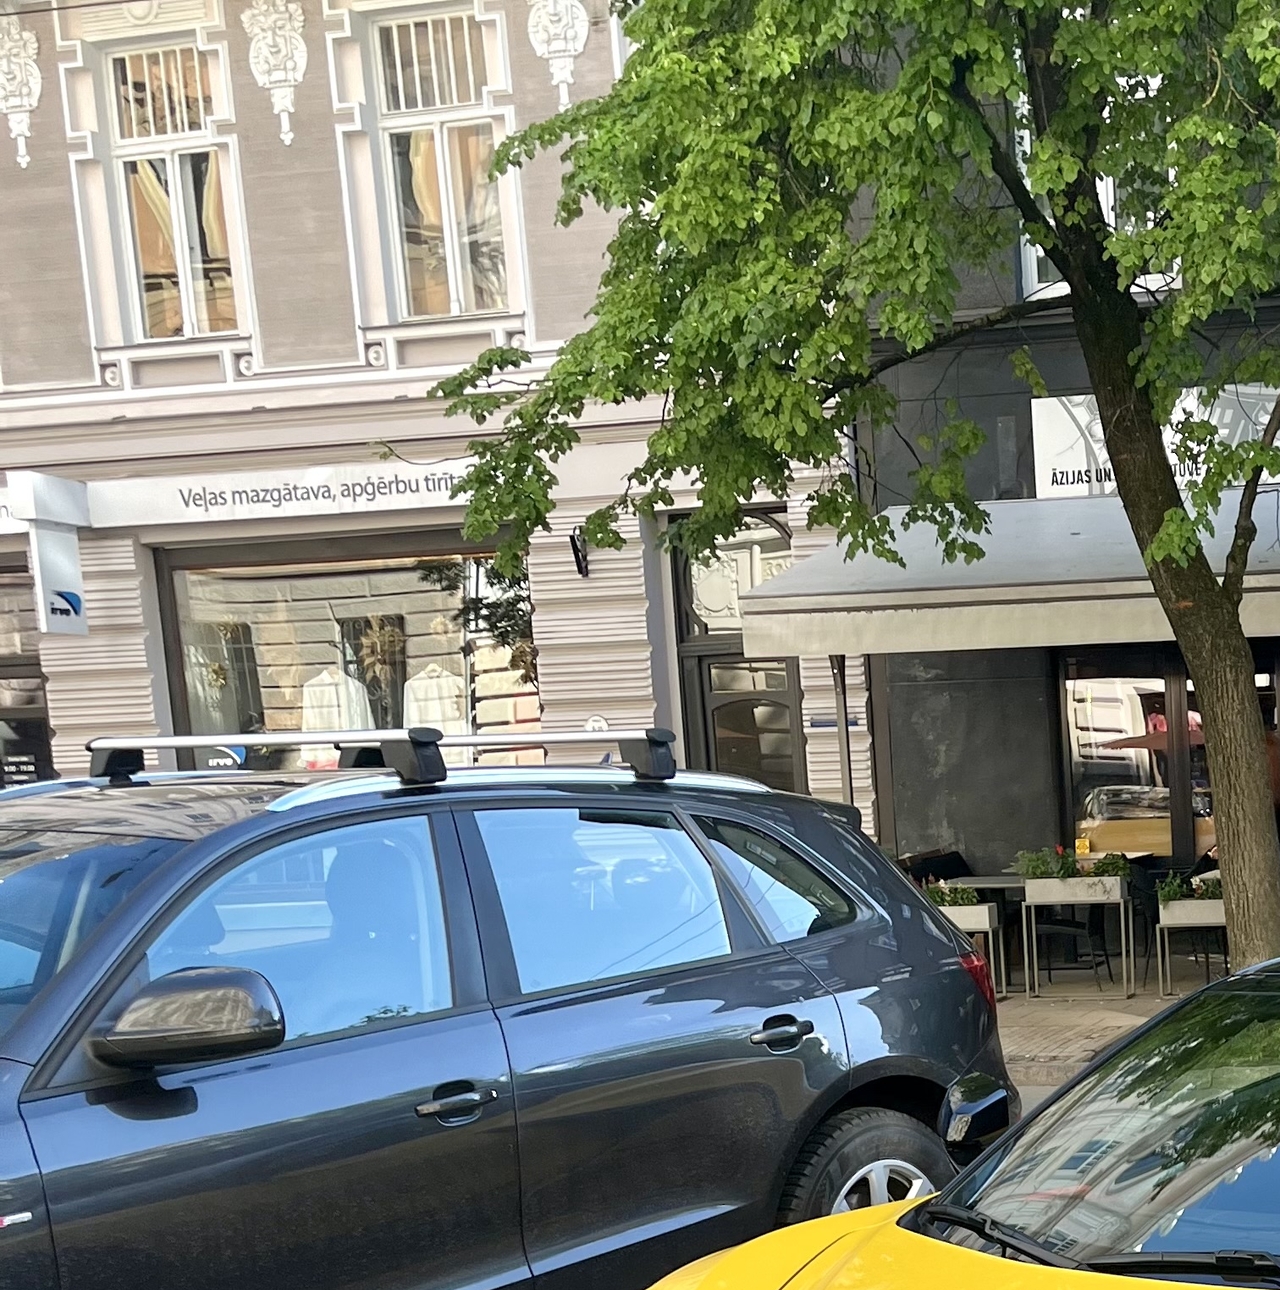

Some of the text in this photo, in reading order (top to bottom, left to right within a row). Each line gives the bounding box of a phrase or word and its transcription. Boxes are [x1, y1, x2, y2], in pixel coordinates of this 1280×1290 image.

[1051, 467, 1092, 487] ĀZIJAS
[1095, 469, 1112, 483] UN
[1171, 461, 1202, 477] TUVE
[179, 472, 467, 512] Veļas mazgātava, apģērbu tīrīt
